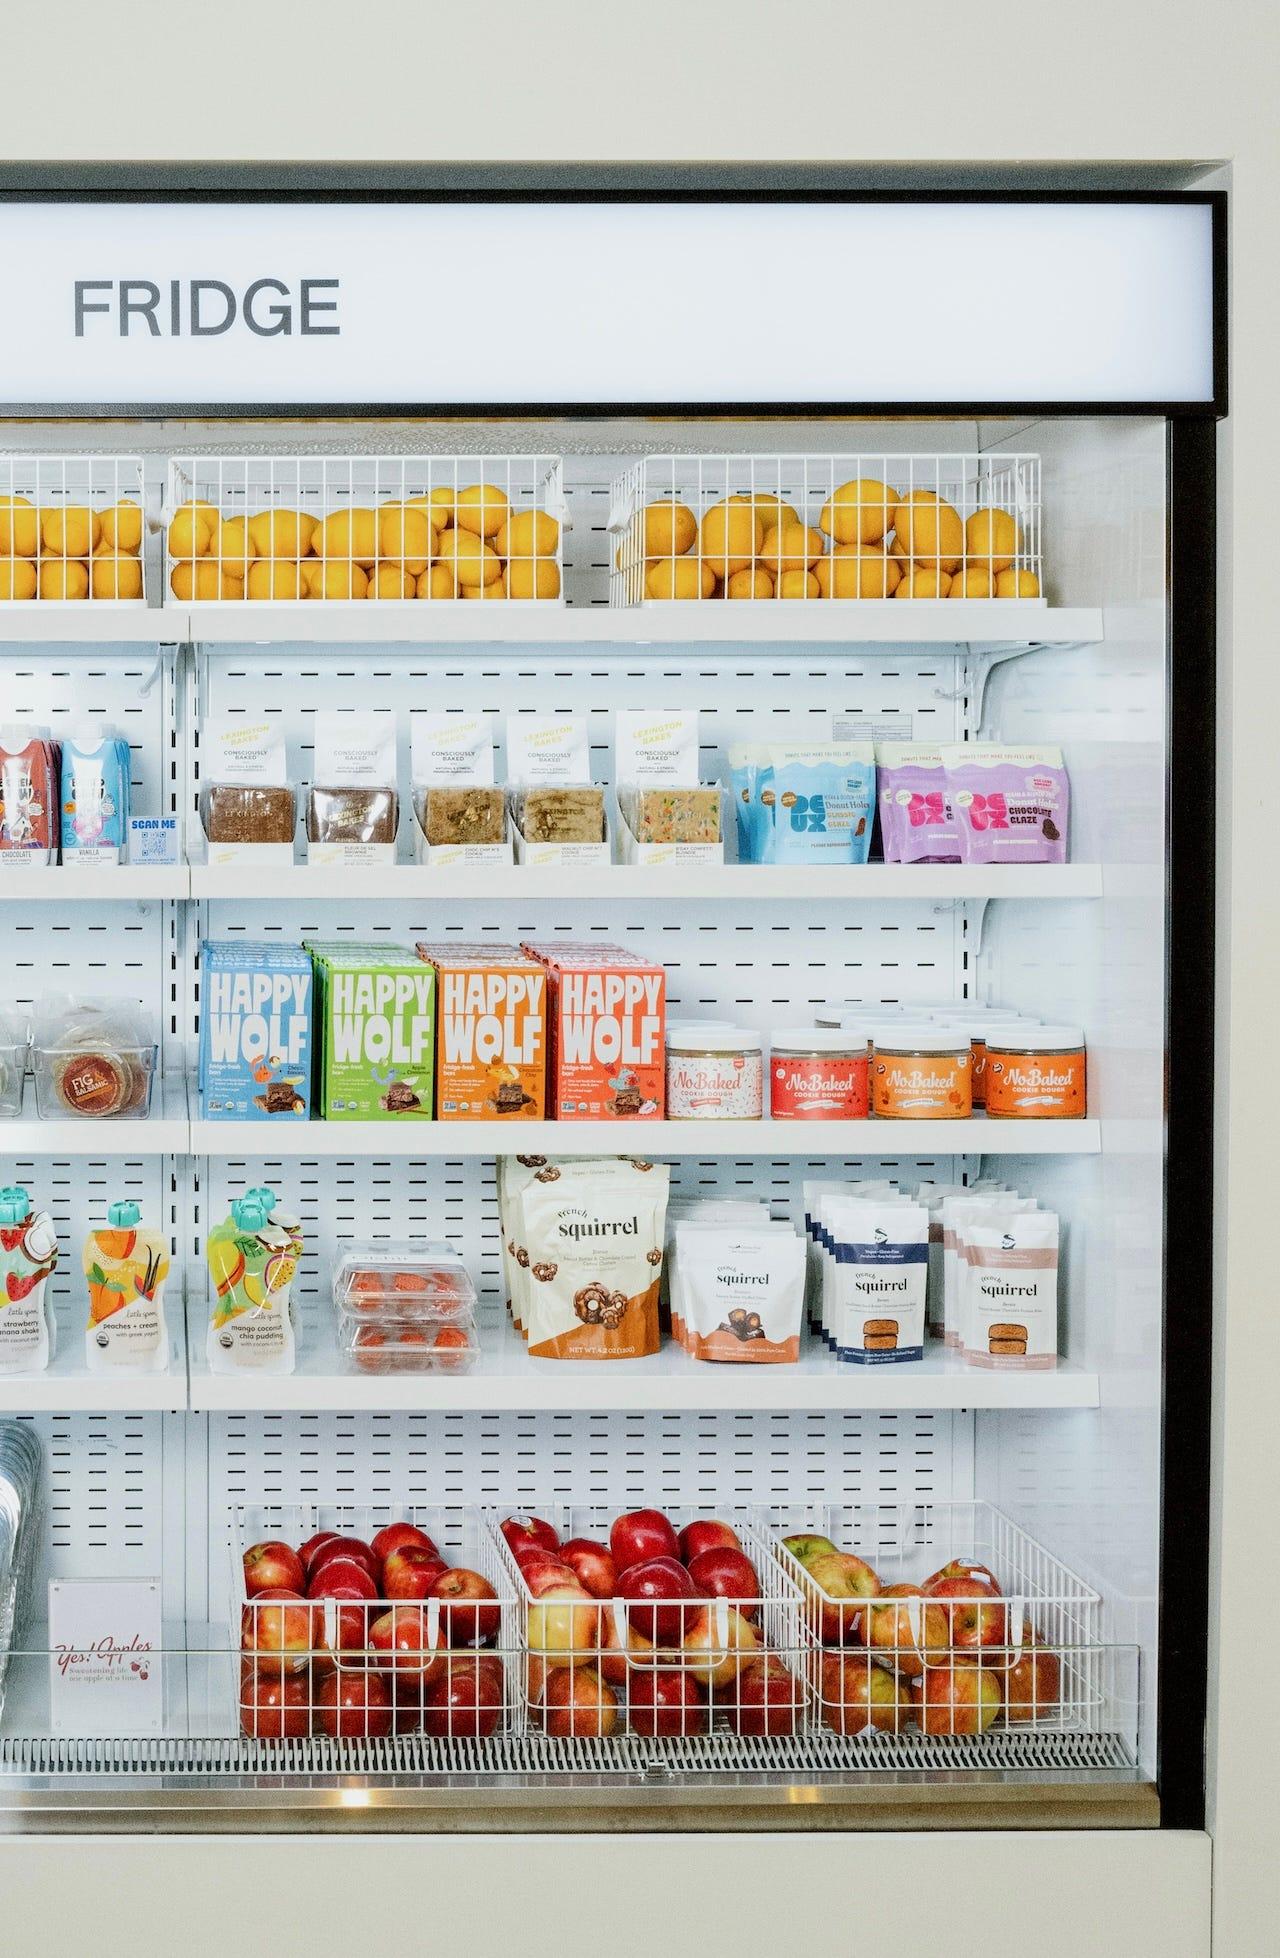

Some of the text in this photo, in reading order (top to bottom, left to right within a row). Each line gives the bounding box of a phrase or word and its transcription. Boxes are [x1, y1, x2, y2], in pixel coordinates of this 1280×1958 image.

[75, 279, 340, 336] FRIDGE
[826, 801, 850, 809] Donut
[1009, 807, 1052, 818] CHOCOLATE
[132, 820, 175, 829] SCAN ME
[338, 815, 364, 827] BAKES
[1011, 816, 1038, 824] GLAZE
[210, 973, 310, 1014] HAPPY
[333, 974, 432, 1014] HAPPY
[444, 974, 544, 1015] HAPPY
[562, 974, 662, 1015] HAPPY
[210, 1014, 307, 1064] WOLF
[333, 1015, 430, 1064] WOLF
[444, 1015, 542, 1064] WOLF
[562, 1015, 660, 1064] WOLF
[71, 1074, 94, 1091] FIG
[75, 1080, 109, 1096] BALSAMIC
[557, 1208, 588, 1219] french
[558, 1216, 639, 1242] squirrel
[717, 1273, 769, 1286] squirrel
[855, 1272, 876, 1280] french
[855, 1278, 907, 1294] squirrel
[981, 1283, 1037, 1298] squirrel
[4, 1320, 39, 1328] strawberry
[257, 1324, 282, 1332] coconut
[256, 1332, 284, 1341] pudding
[55, 1633, 152, 1676] Yes! Apples
[84, 1675, 103, 1684] apple
